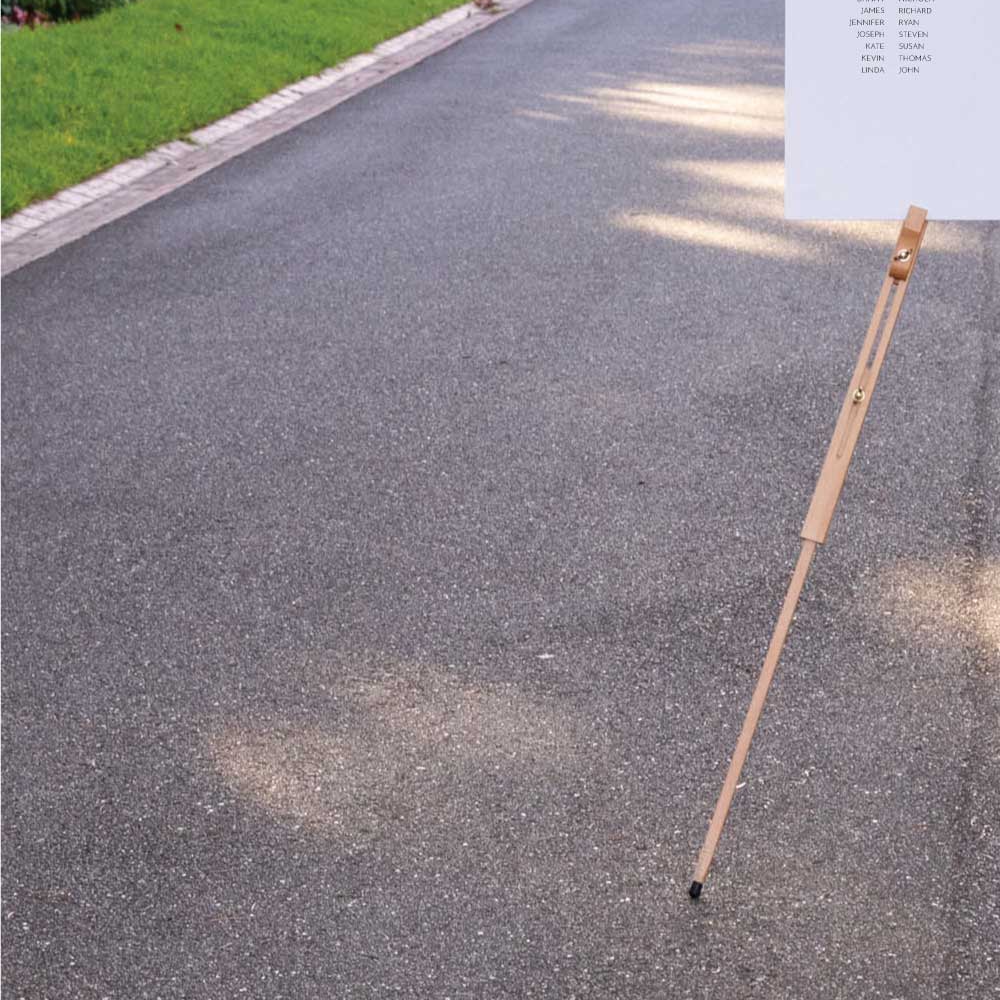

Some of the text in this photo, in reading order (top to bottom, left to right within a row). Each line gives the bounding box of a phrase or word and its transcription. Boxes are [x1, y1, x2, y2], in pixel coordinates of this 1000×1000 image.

[860, 6, 885, 15] JAMES
[898, 6, 933, 15] RICHARD
[848, 18, 886, 27] JENNIFER
[897, 18, 920, 27] RYAN
[855, 30, 885, 39] JOSEPH
[898, 30, 929, 39] STEVEN
[865, 42, 885, 51] KATE
[898, 42, 925, 51] SUSAN
[861, 53, 885, 62] KEVIN
[898, 53, 933, 62] THOMAS
[860, 65, 885, 74] LINDA
[898, 66, 920, 75] JOHN
